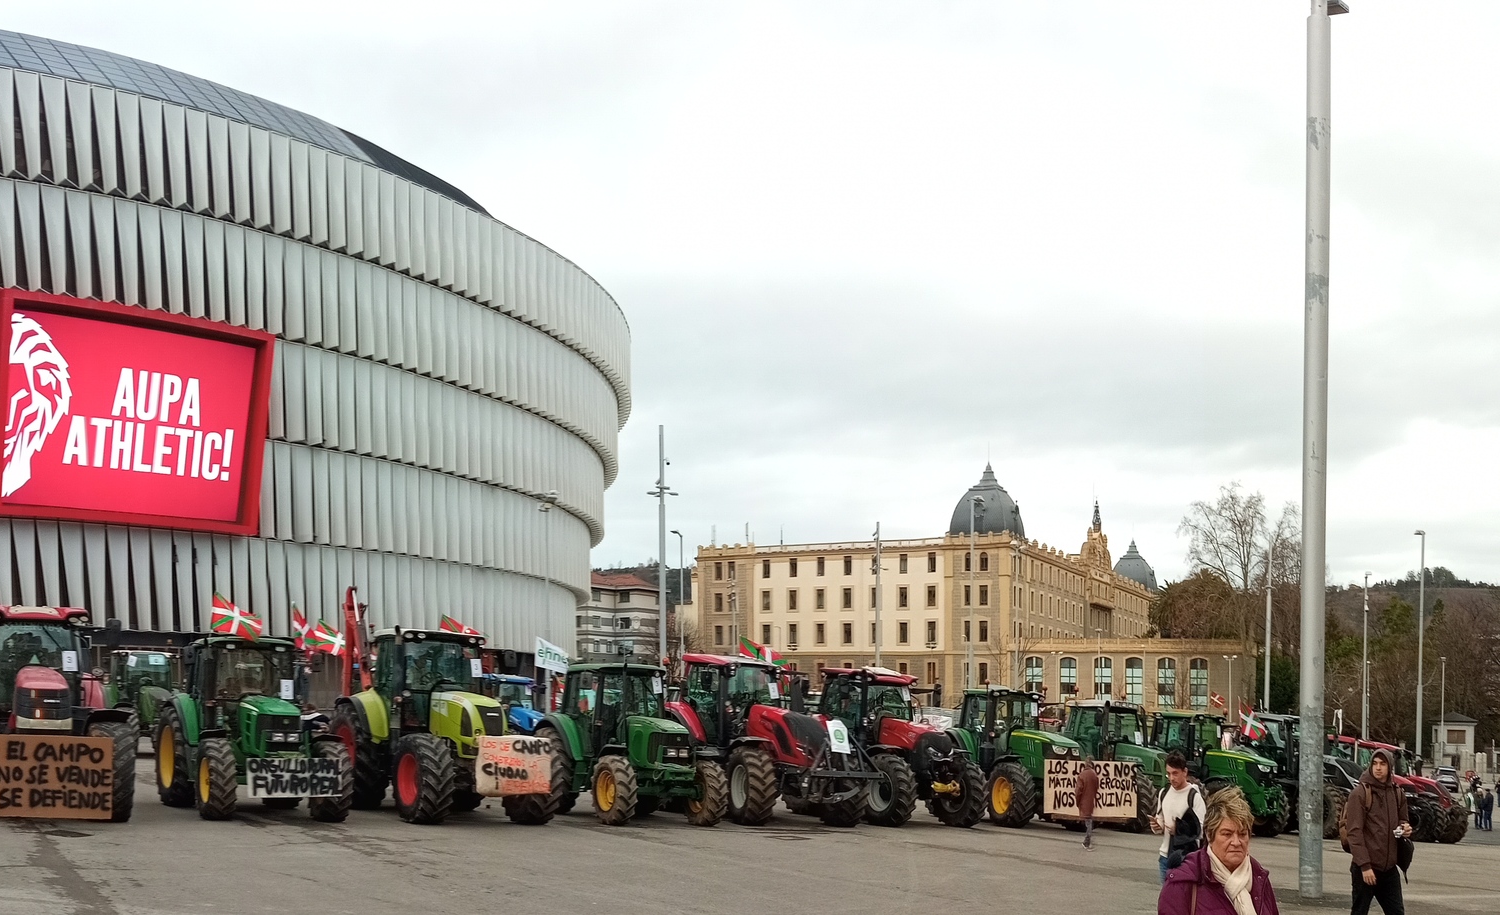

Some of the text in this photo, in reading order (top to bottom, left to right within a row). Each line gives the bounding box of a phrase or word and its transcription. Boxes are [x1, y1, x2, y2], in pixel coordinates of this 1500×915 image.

[111, 367, 201, 427] AUPA
[62, 414, 235, 482] ATHLETIC!
[6, 740, 105, 764] EL CAMPO
[512, 739, 551, 755] CAMPO
[25, 764, 49, 785] SE
[55, 765, 112, 788] VENDE
[248, 758, 307, 774] ORGULLO
[481, 762, 529, 780] CIUDAD
[1047, 760, 1137, 779] LOS LOOS NOS
[253, 773, 341, 796] FUTURO REAL
[1100, 777, 1138, 794] ERCOSUR
[29, 785, 111, 811] DEFIENDE
[1053, 790, 1076, 810] NOS
